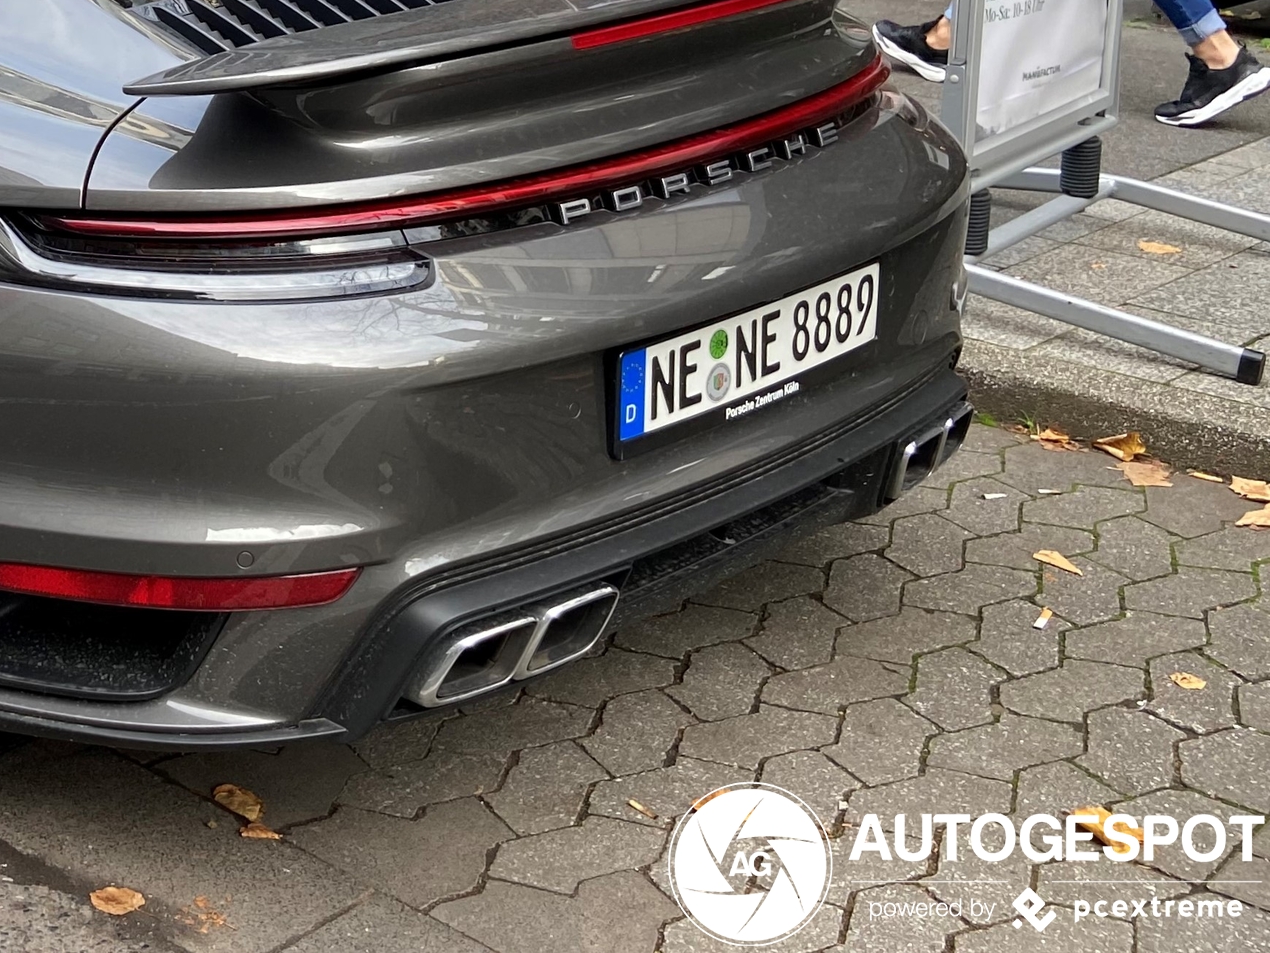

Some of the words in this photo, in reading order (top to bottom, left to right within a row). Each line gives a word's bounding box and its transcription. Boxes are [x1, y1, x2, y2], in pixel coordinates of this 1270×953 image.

[559, 121, 839, 225] PORSCHE
[625, 403, 636, 424] D
[650, 339, 702, 421] NE
[735, 309, 781, 388] NE
[792, 273, 874, 362] 8889
[725, 400, 755, 420] Porsche
[755, 388, 784, 408] Zentrum
[783, 380, 800, 396] Köln
